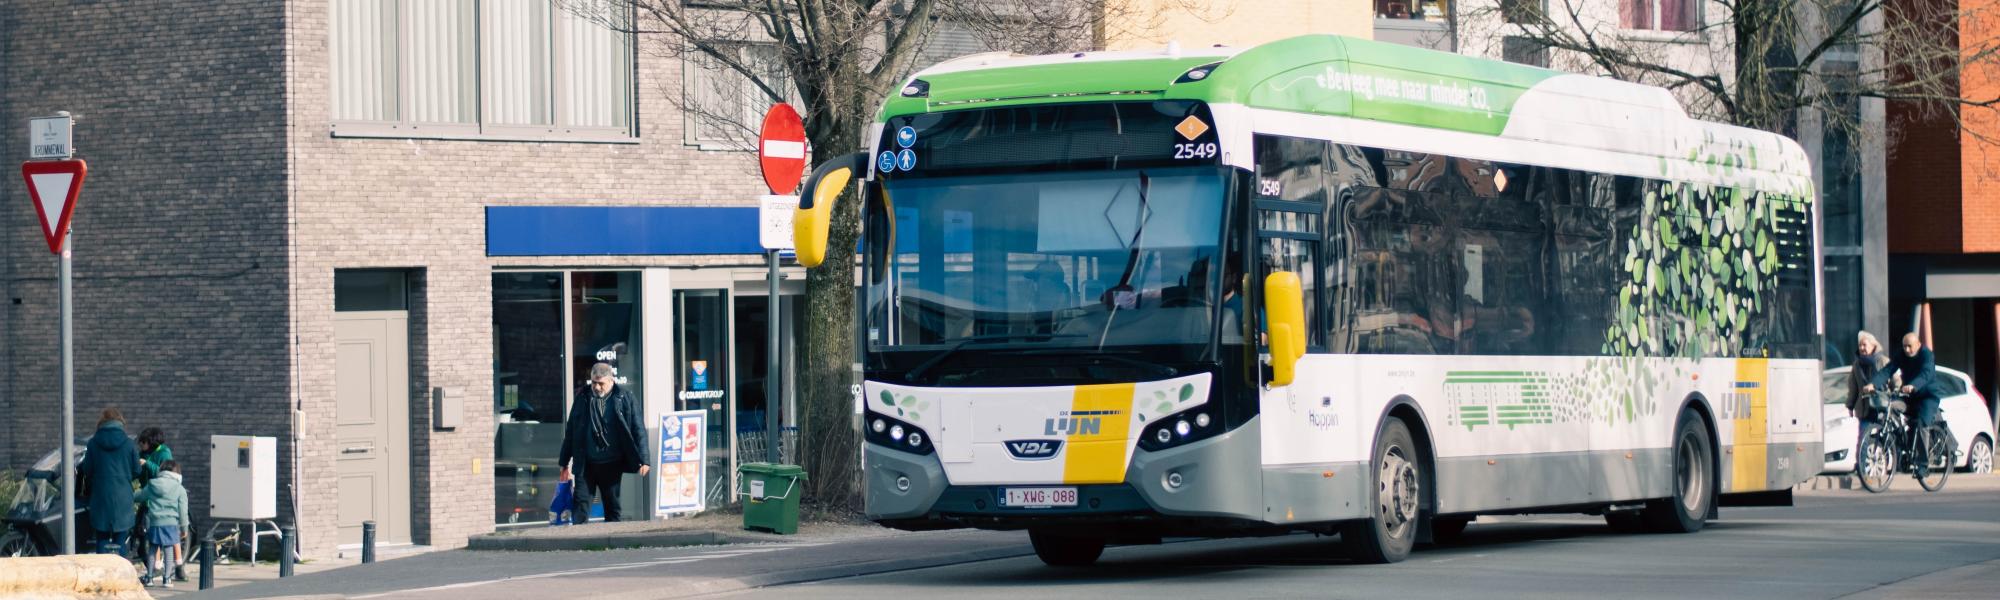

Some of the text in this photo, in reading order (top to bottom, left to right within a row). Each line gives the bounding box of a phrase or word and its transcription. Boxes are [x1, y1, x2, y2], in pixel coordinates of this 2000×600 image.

[1326, 66, 1374, 101] Beweeg
[1375, 77, 1400, 98] mee
[1401, 80, 1428, 102] naar
[1431, 80, 1468, 108] minder
[1174, 143, 1218, 160] 2549
[1261, 180, 1281, 196] 2549
[596, 350, 617, 361] OPEN
[1044, 418, 1101, 436] LIJN
[1308, 409, 1339, 431] Hoppin
[1011, 442, 1053, 455] VDL
